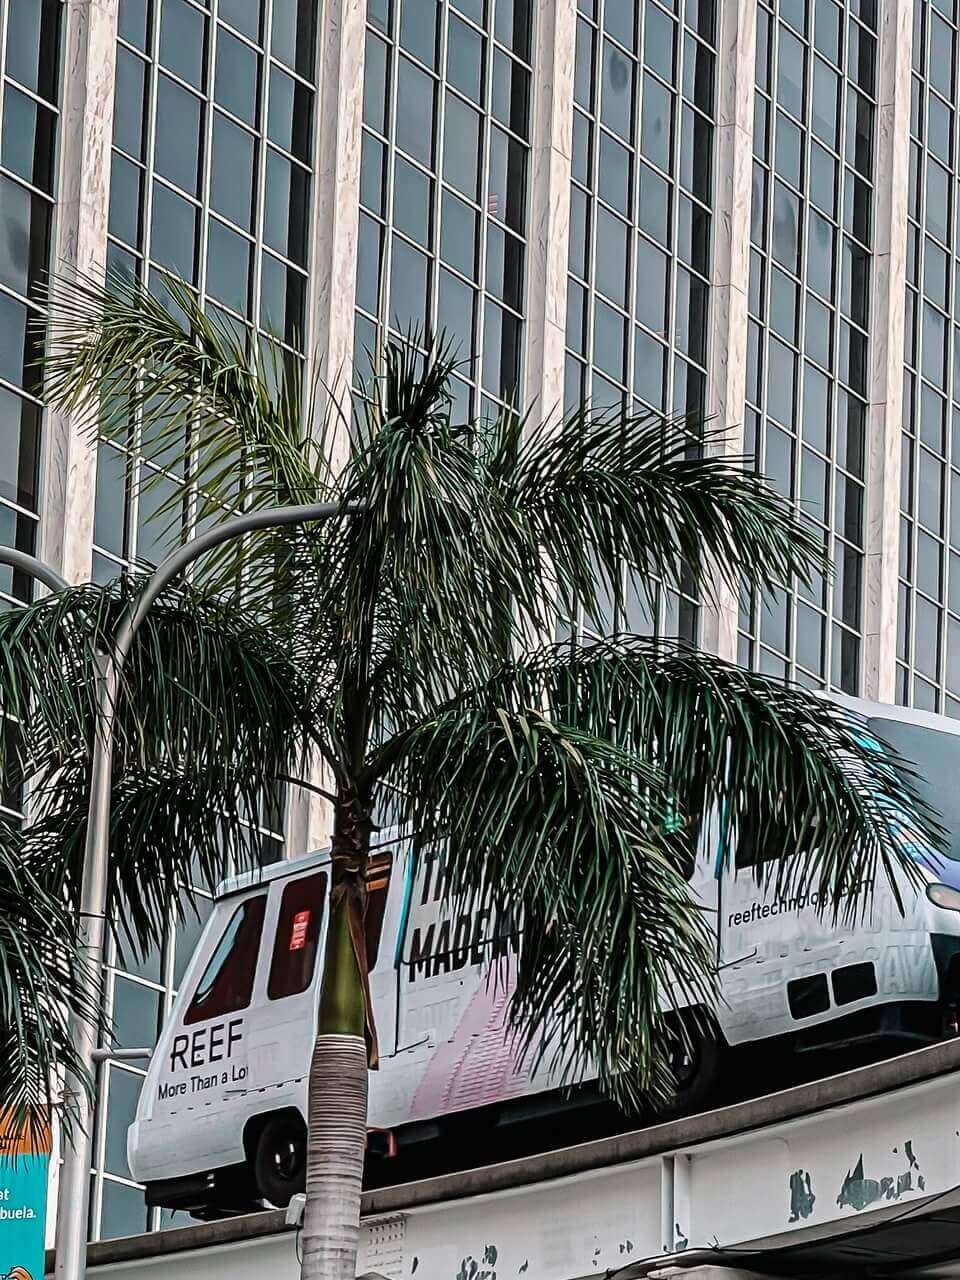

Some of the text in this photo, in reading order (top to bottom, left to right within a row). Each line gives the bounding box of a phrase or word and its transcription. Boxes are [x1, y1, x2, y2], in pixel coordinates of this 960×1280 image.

[169, 1018, 243, 1073] REEF
[158, 1082, 187, 1101] More
[190, 1074, 218, 1093] Than
[221, 1071, 228, 1084] a
